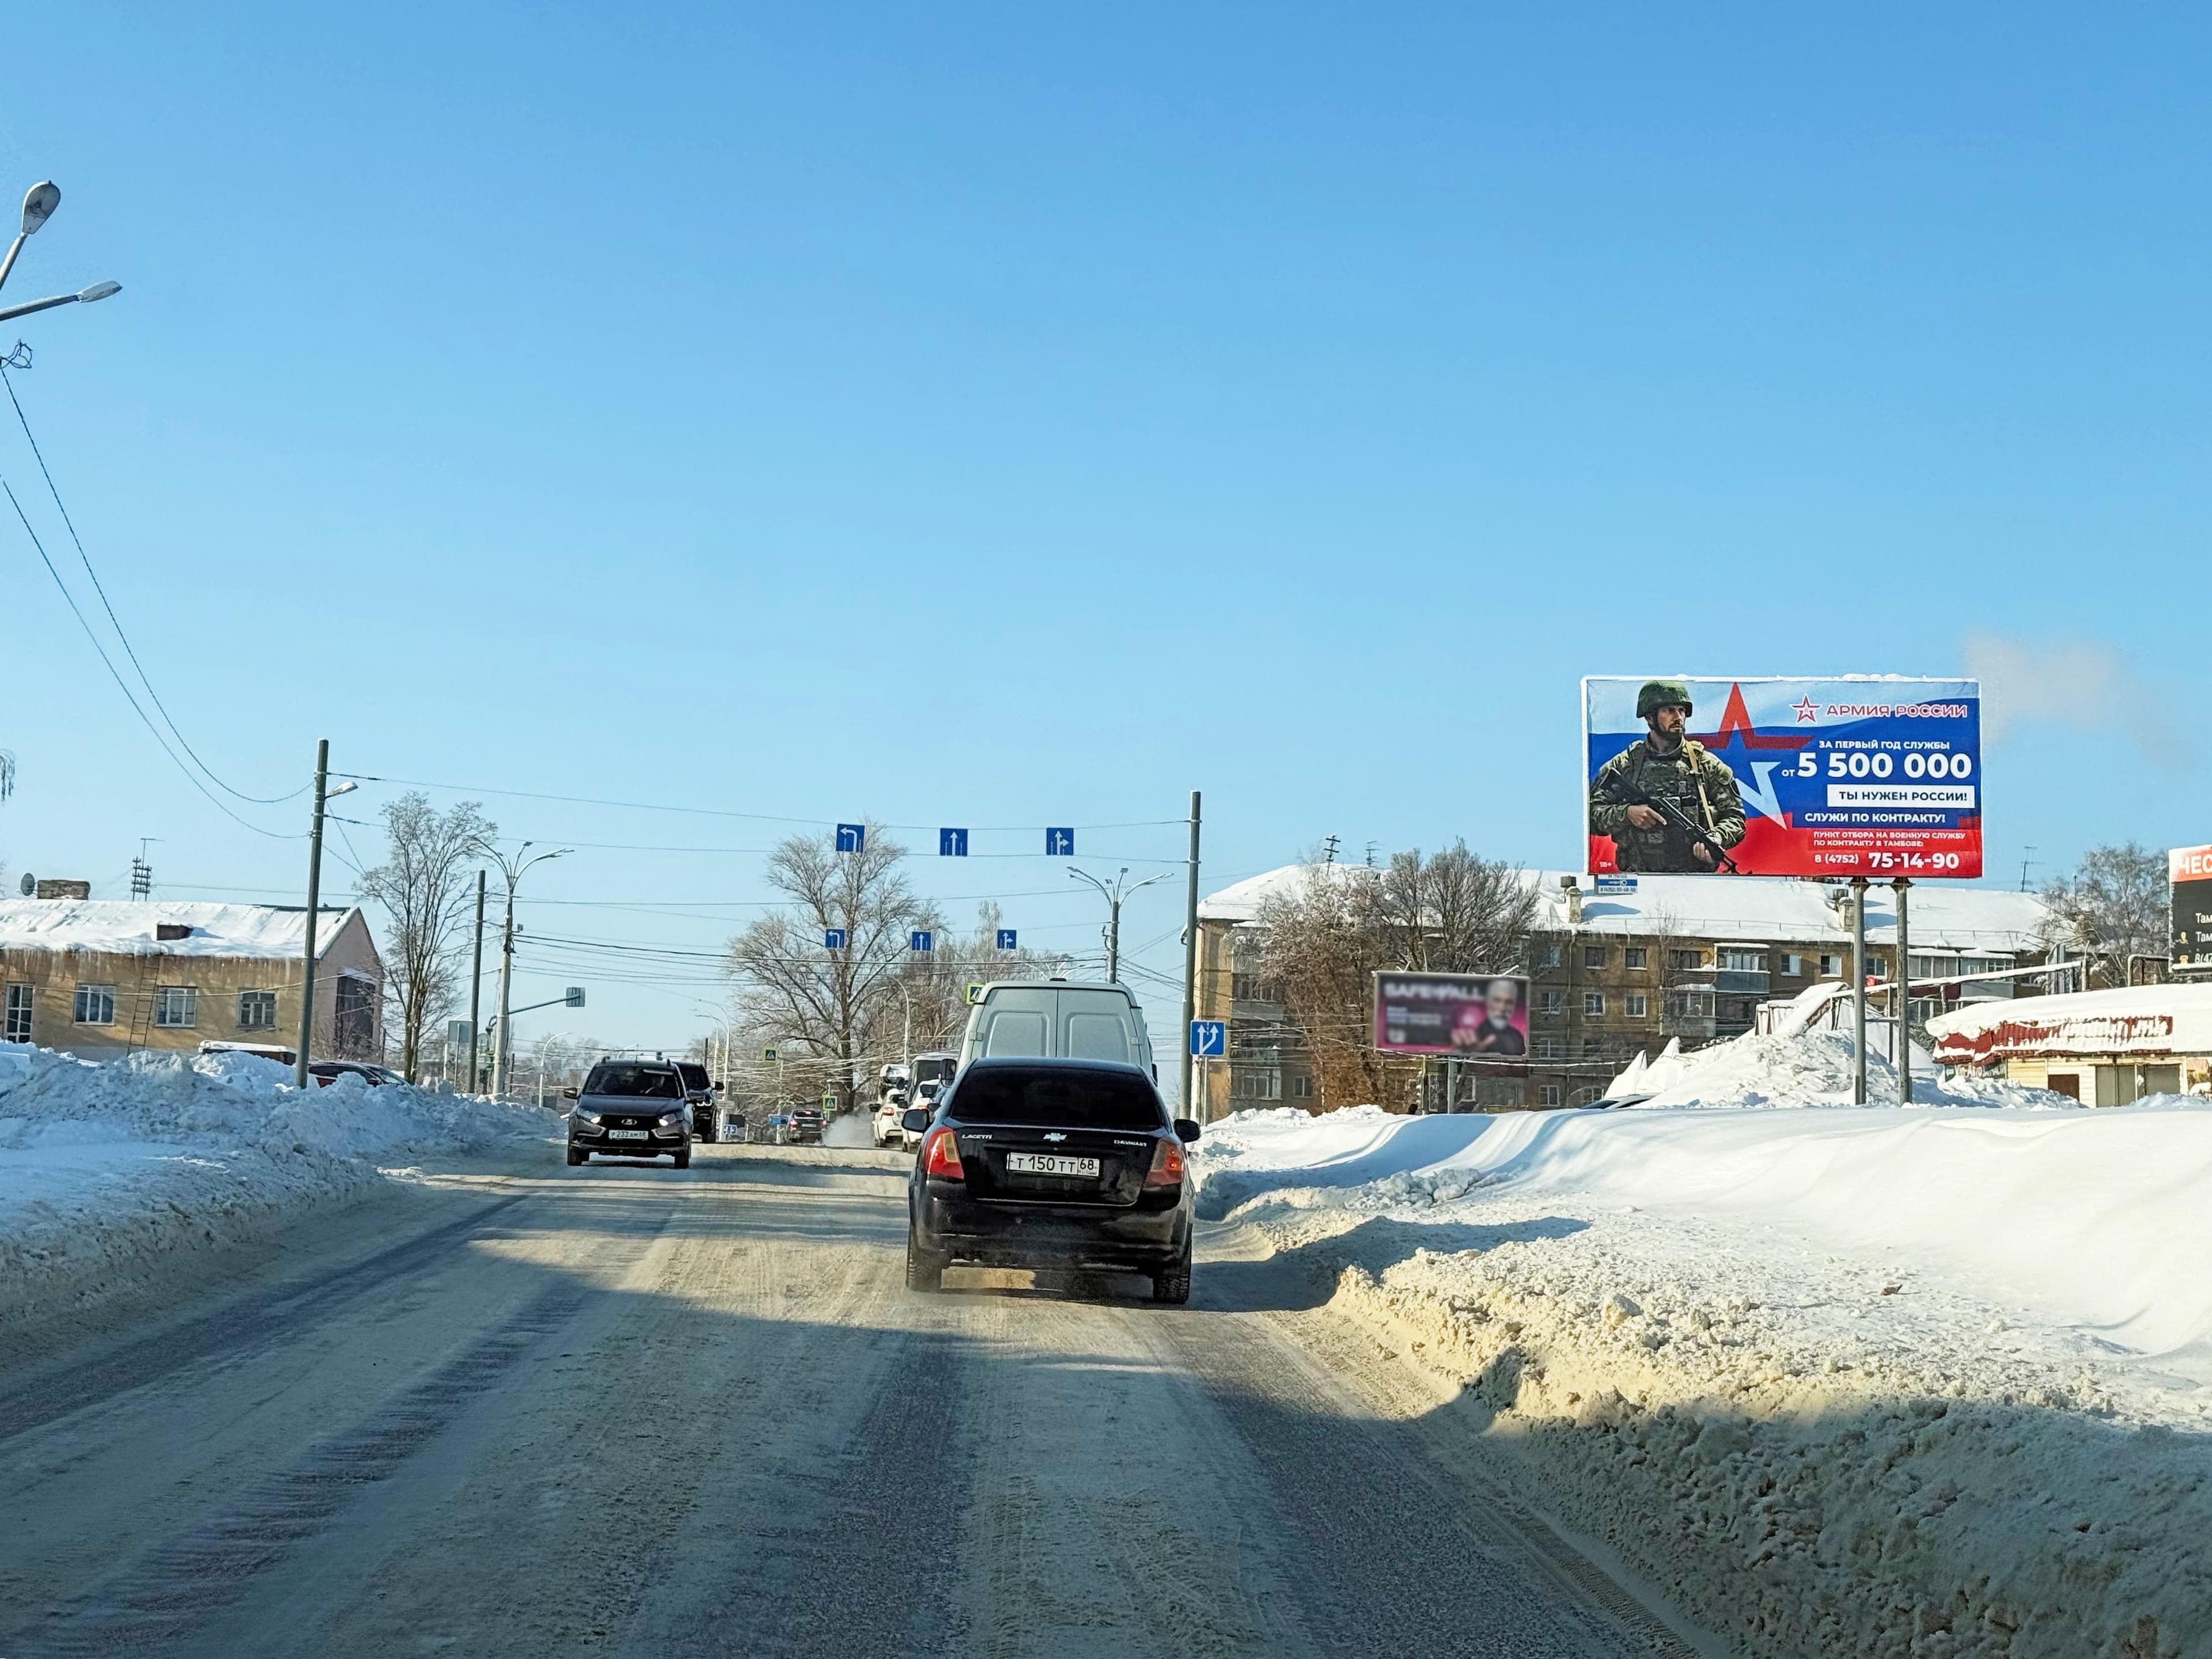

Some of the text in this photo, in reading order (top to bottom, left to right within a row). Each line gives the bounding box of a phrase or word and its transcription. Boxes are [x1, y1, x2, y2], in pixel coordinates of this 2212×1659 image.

[1826, 704, 1968, 718] АРМИЯ РОССИИ
[1819, 740, 1950, 750] ЗА ПЕРВЫЙ ГОД СЛУЖБЫ
[1797, 752, 1817, 777] 5
[1827, 752, 1893, 778] 500
[1904, 753, 1972, 778] 000
[1839, 791, 1968, 801] ТЫ НУЖЕН РОССИИ!
[1805, 812, 1946, 824] СЛУЖИ ПО КОНТРАКТУ!
[1815, 853, 1959, 869] 8 (4752) 75-14-90
[1080, 1158, 1094, 1170] 68
